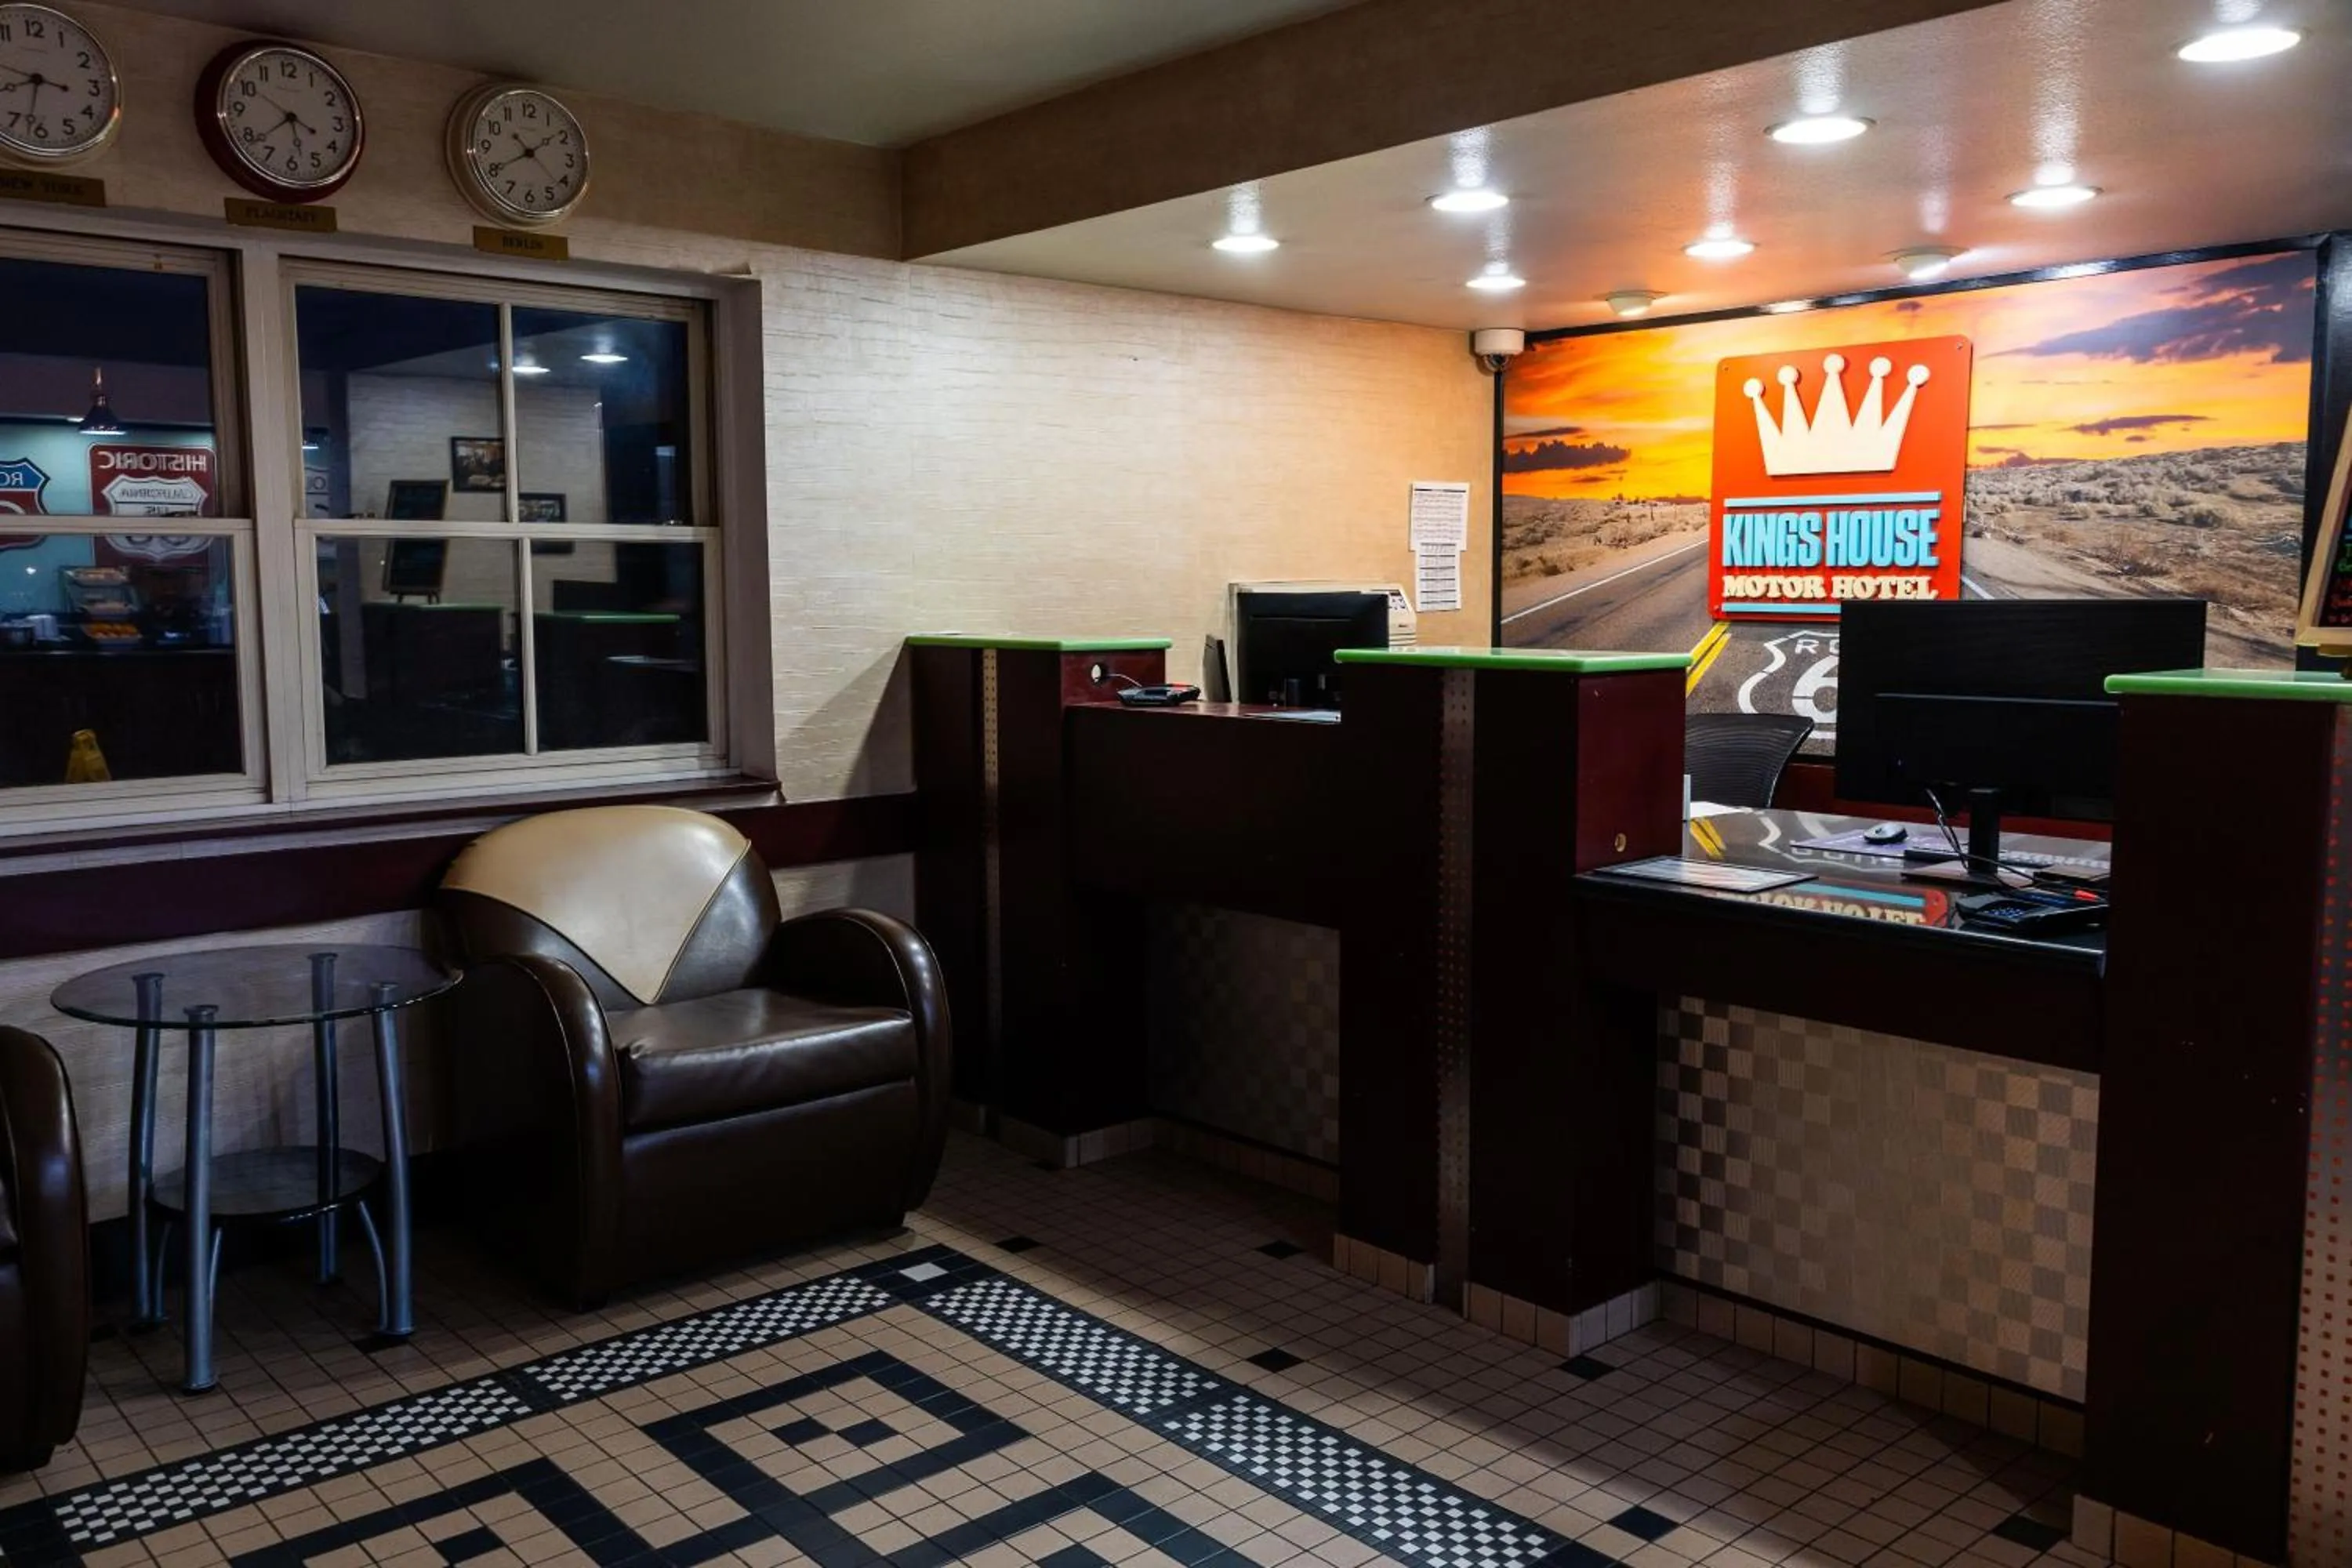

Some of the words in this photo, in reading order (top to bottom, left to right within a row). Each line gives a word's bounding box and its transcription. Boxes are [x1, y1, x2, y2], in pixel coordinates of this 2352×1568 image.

[0, 24, 11, 42] 11
[25, 20, 45, 38] 12
[77, 52, 90, 68] 2
[259, 65, 268, 82] 11
[281, 61, 296, 78] 12
[88, 79, 100, 96] 3
[241, 80, 256, 97] 10
[325, 91, 336, 107] 2
[81, 105, 94, 119] 4
[234, 101, 245, 117] 9
[504, 107, 512, 122] 11
[522, 103, 537, 118] 12
[8, 111, 21, 127] 7
[63, 118, 75, 135] 5
[332, 117, 343, 132] 3
[34, 123, 48, 138] 6
[243, 127, 254, 142] 8
[488, 120, 501, 136] 10
[559, 130, 568, 144] 2
[264, 146, 275, 161] 7
[327, 140, 337, 153] 4
[481, 140, 491, 154] 9
[286, 156, 298, 171] 6
[310, 153, 321, 168] 5
[564, 154, 574, 168] 3
[488, 162, 498, 177] 8
[506, 180, 515, 194] 7
[559, 175, 568, 187] 4
[524, 190, 535, 203] 6
[545, 187, 554, 200] 5
[1722, 513, 1822, 567] KINGS
[1825, 509, 1940, 567] HOUSE
[1722, 575, 1826, 599] MOTOR
[1831, 575, 1938, 600] HOTEL
